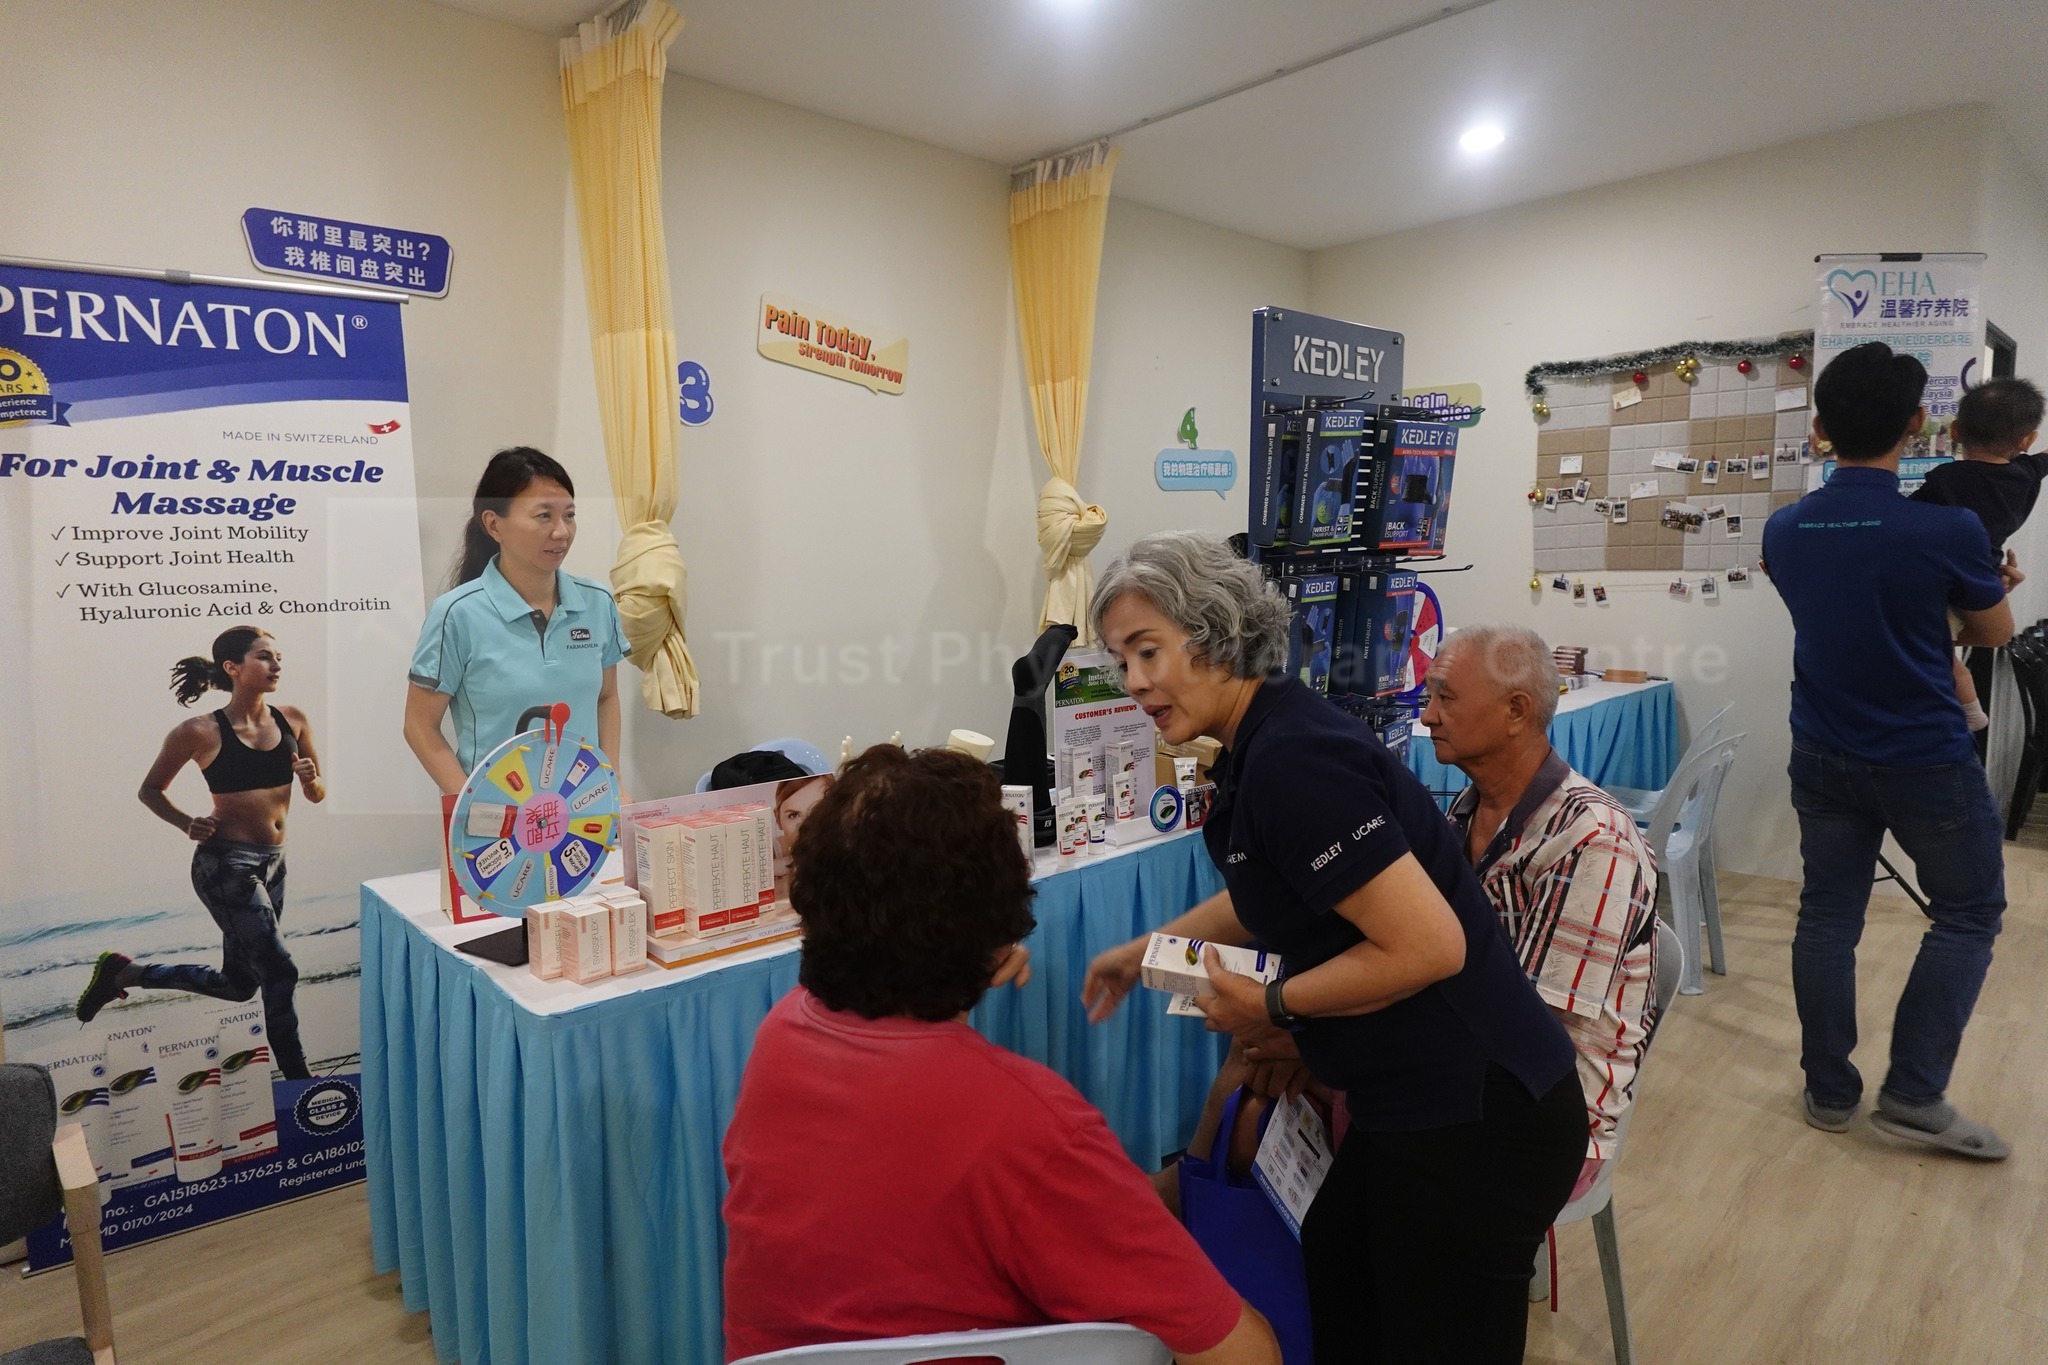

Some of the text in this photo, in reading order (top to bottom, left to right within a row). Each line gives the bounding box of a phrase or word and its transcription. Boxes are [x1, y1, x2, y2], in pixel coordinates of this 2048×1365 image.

[270, 216, 431, 260] 你那里最突出?
[284, 246, 426, 287] 我椎间盘突出
[1881, 271, 1936, 296] EHA
[1880, 299, 1969, 318] 温馨疗养院
[765, 304, 811, 341] Pain
[1840, 321, 1878, 329] EMBRACE
[798, 342, 903, 385] Strength Tomorrow
[1293, 334, 1385, 384] KEDLEY
[1180, 407, 1198, 449] 4
[1325, 416, 1361, 428] KEDLEY
[223, 431, 379, 445] MADE IN SWITZERLAND
[1400, 428, 1444, 446] KEDLEY
[0, 453, 384, 483] For Joint & Muscle
[111, 491, 297, 522] Massage
[1369, 490, 1377, 509] BACK
[71, 526, 310, 543] Improve Joint Mobility
[1386, 530, 1409, 538] SUPPORT
[1388, 521, 1405, 530] BACK
[76, 550, 295, 569] Support Joint Health
[77, 580, 278, 598] With Glucosamine,
[1305, 581, 1336, 594] KEDLEY
[1390, 577, 1416, 589] KEDLEY
[80, 597, 391, 624] Hyaluronic Acid & Chondroitin
[1075, 704, 1137, 720] CUSTOMER'S REVIEWS
[543, 749, 556, 784] UCARE
[574, 783, 610, 811] UCARE
[757, 817, 768, 889] PERFEKTE HAUT
[1310, 815, 1386, 872] KEDLEY UCARE
[666, 841, 678, 909] PERFECT SKIN
[709, 833, 722, 910] PERFEKTE HAUT
[740, 828, 751, 904] PERFEKTE HAUT
[513, 861, 533, 899] UCARE
[158, 1034, 218, 1055] PERNATON
[309, 1104, 337, 1115] CLASS
[312, 1095, 343, 1106] MEDICAL
[315, 1111, 341, 1120] DEVICE
[144, 1161, 283, 1208] GA1518623-137625
[287, 1158, 298, 1171] &
[279, 1163, 343, 1188] Registered
[122, 1203, 193, 1232] 0170/2024
